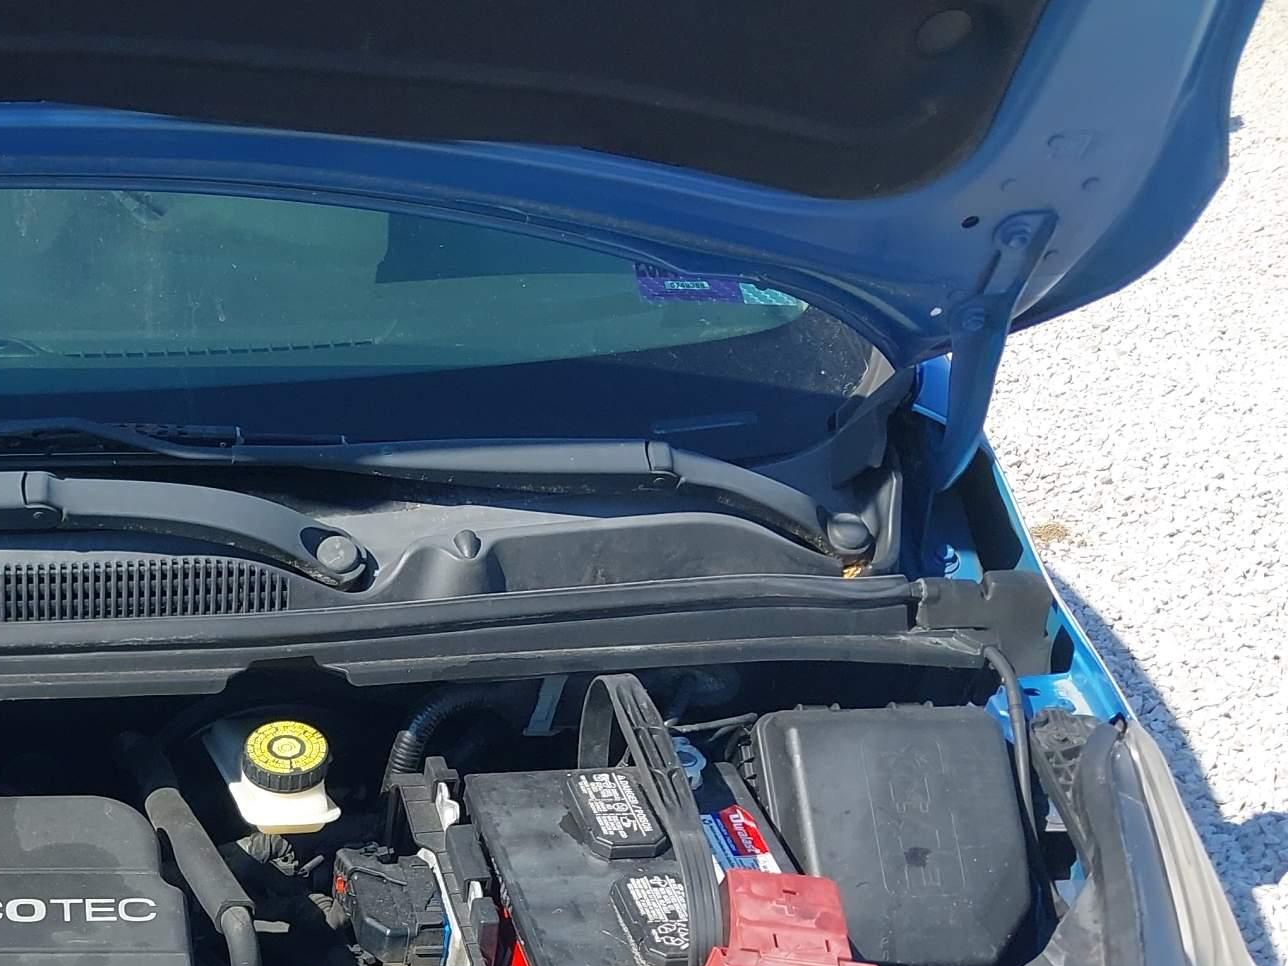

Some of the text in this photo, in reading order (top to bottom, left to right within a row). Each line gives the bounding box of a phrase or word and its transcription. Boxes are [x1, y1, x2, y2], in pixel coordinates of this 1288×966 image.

[620, 780, 639, 805] DANGER
[635, 809, 654, 832] POISON
[729, 808, 762, 855] Duralast
